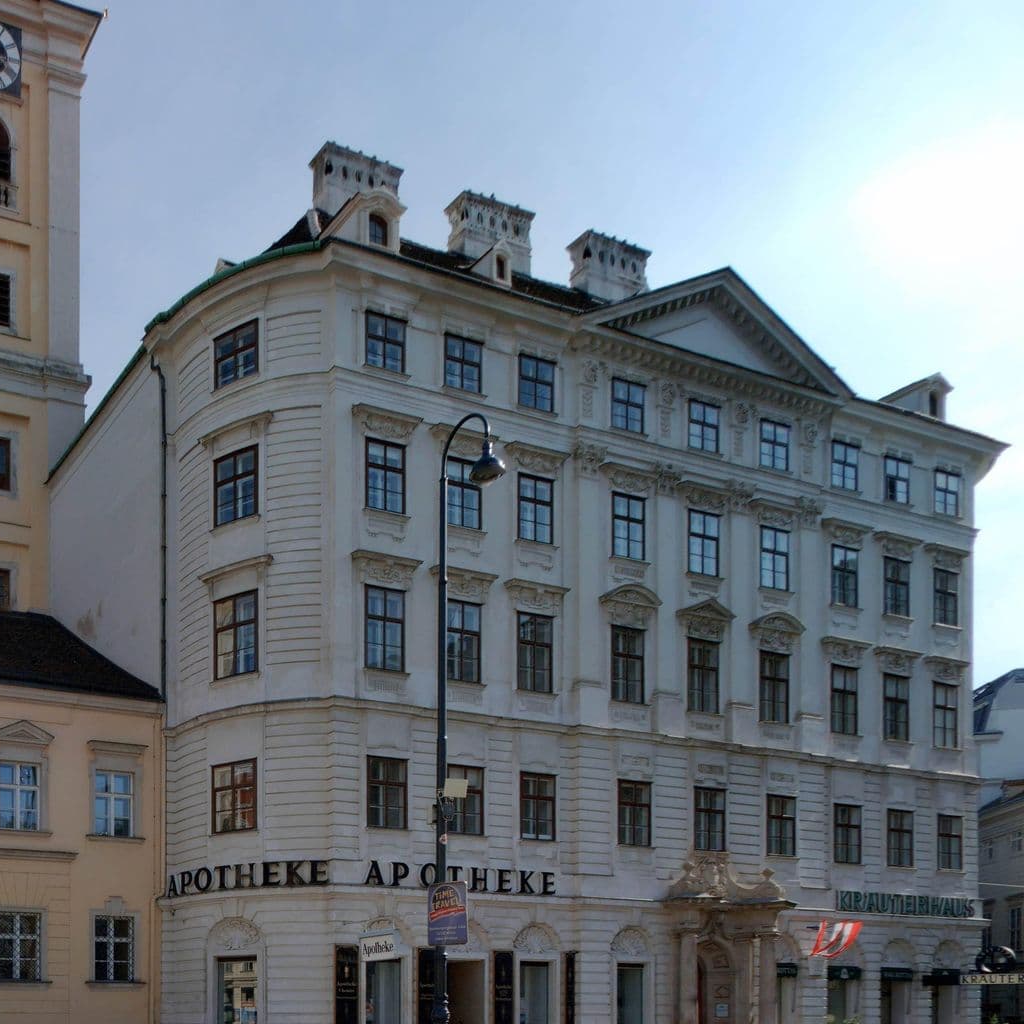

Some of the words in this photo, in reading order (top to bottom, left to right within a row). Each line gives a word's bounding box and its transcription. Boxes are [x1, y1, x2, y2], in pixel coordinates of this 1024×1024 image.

[167, 860, 329, 897] APOTHEKE
[365, 860, 556, 894] APOTHEKE
[363, 941, 394, 957] Apotheke
